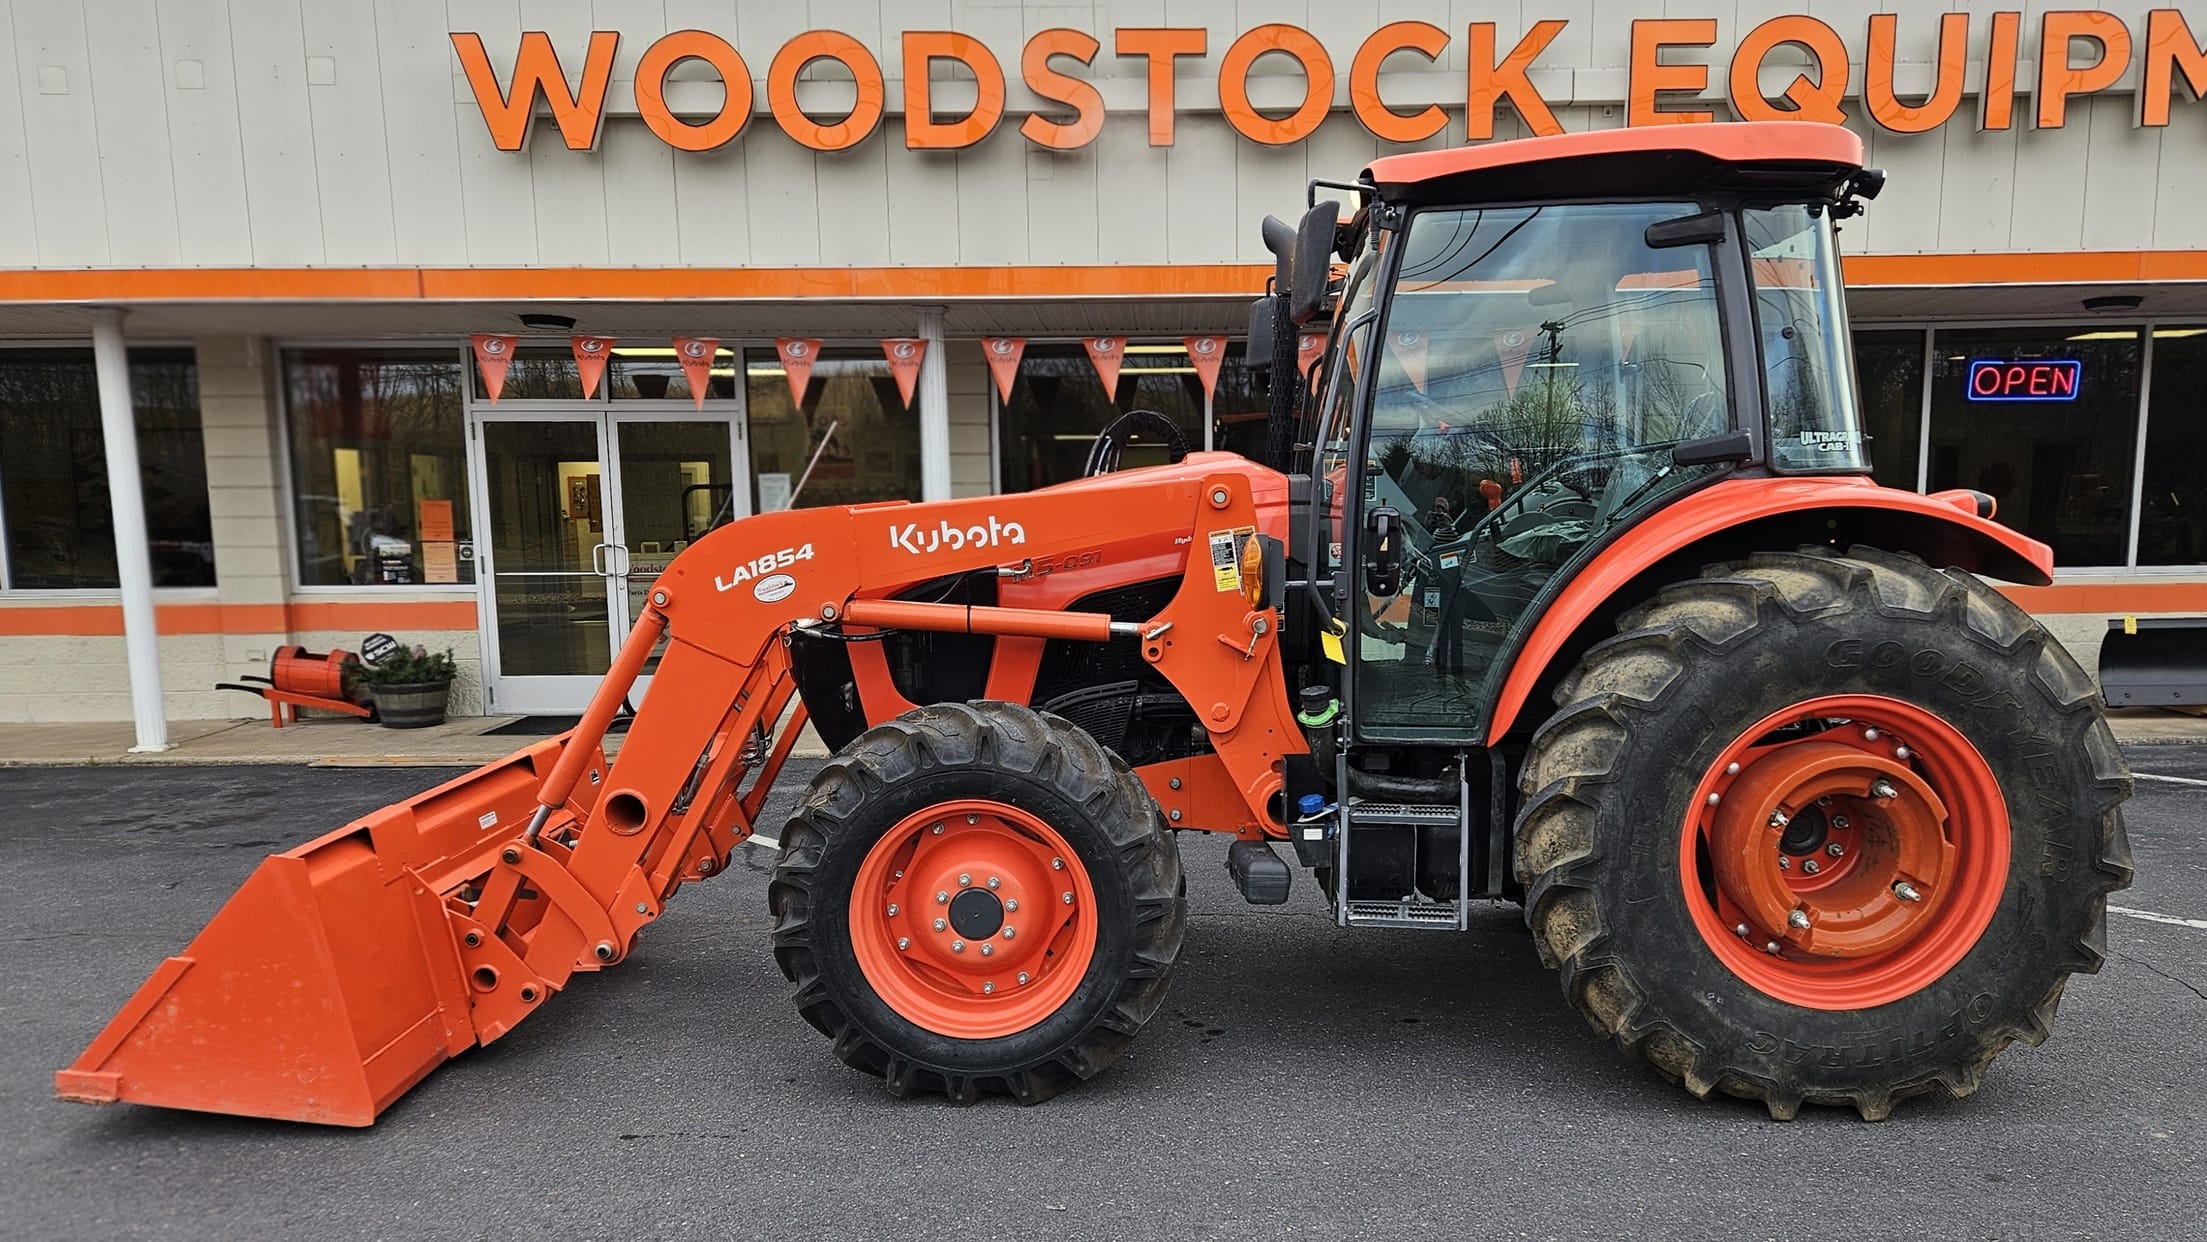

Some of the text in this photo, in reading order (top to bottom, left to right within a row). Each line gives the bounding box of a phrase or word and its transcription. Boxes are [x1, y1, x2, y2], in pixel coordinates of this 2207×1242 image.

[450, 20, 1570, 152] WOODSTOCK
[1974, 366, 2075, 395] OPEN
[889, 515, 1026, 554] Kubota
[629, 563, 667, 574] oodst
[714, 543, 815, 592] LA1854
